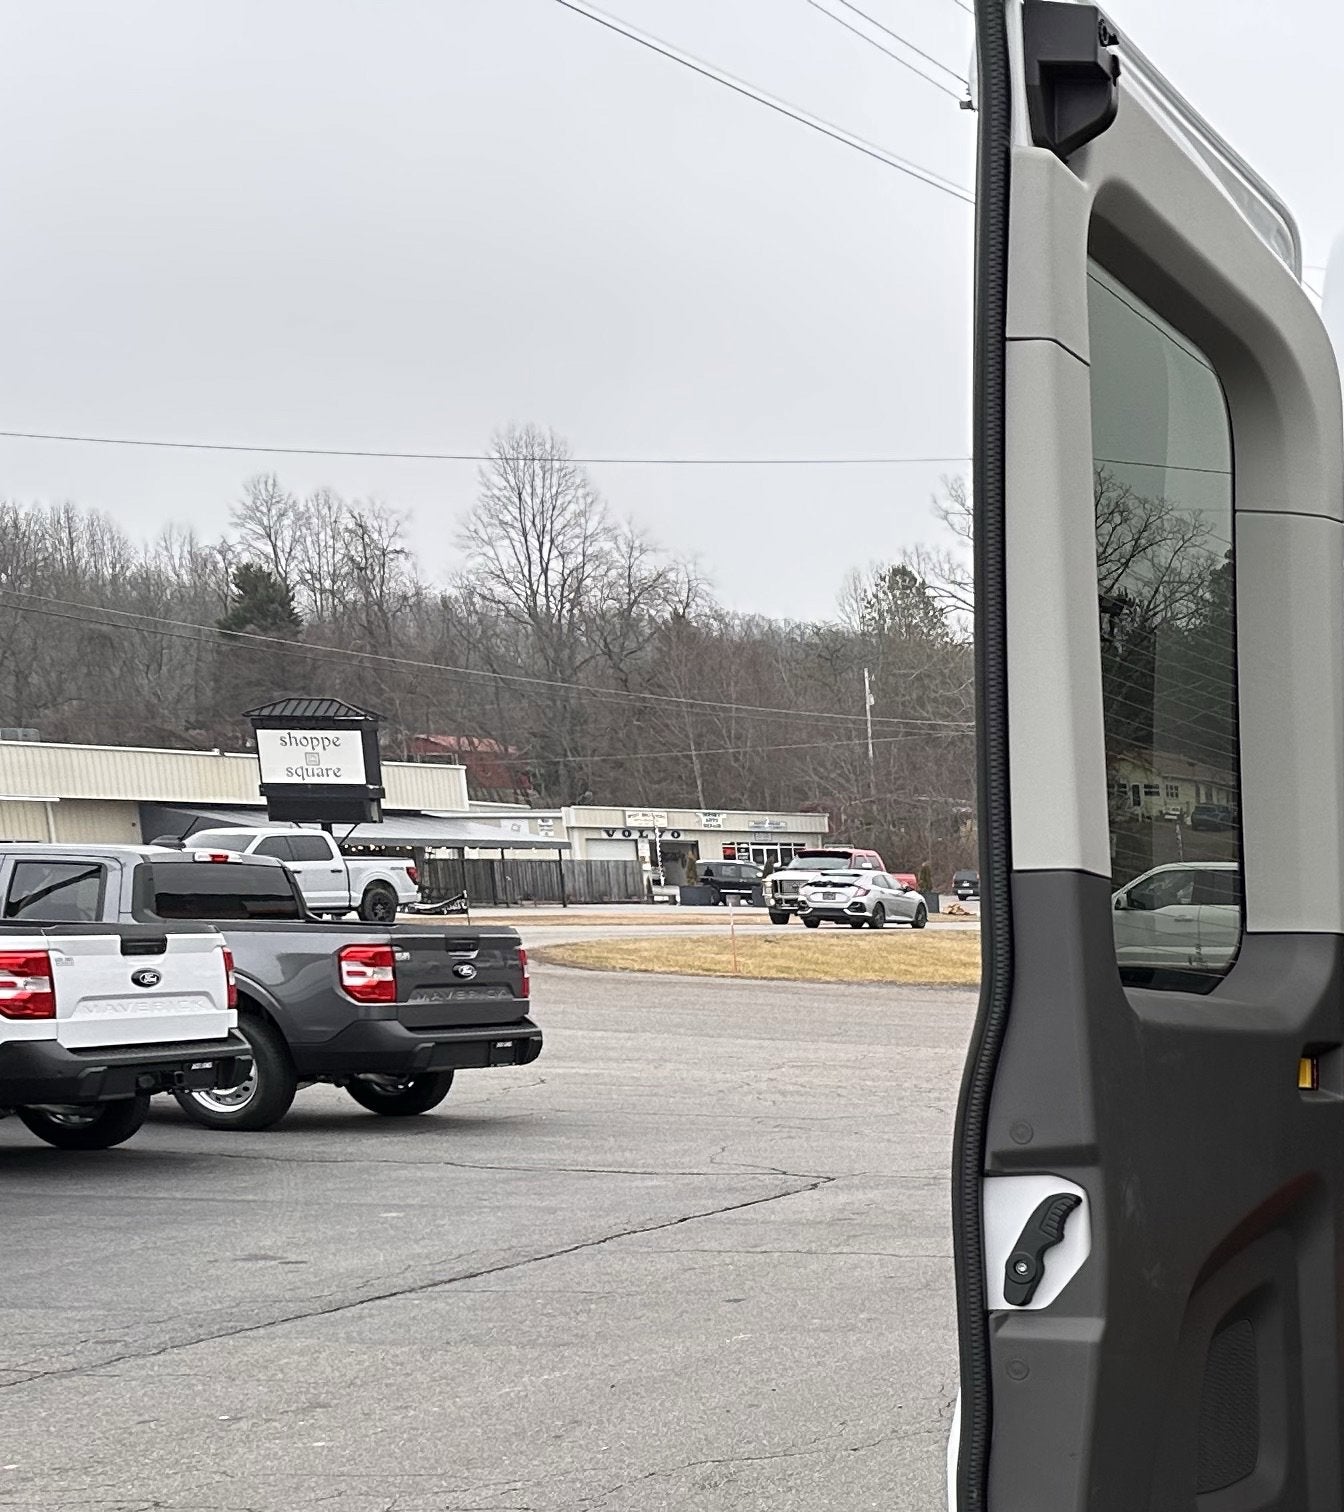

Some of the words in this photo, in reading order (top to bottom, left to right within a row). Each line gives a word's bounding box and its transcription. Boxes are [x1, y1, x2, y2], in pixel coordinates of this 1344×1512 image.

[280, 732, 341, 751] shoppe
[286, 766, 341, 780] square
[603, 829, 681, 839] VOLVO
[413, 989, 508, 1002] MAVERICK
[81, 999, 206, 1015] MAVERICK
